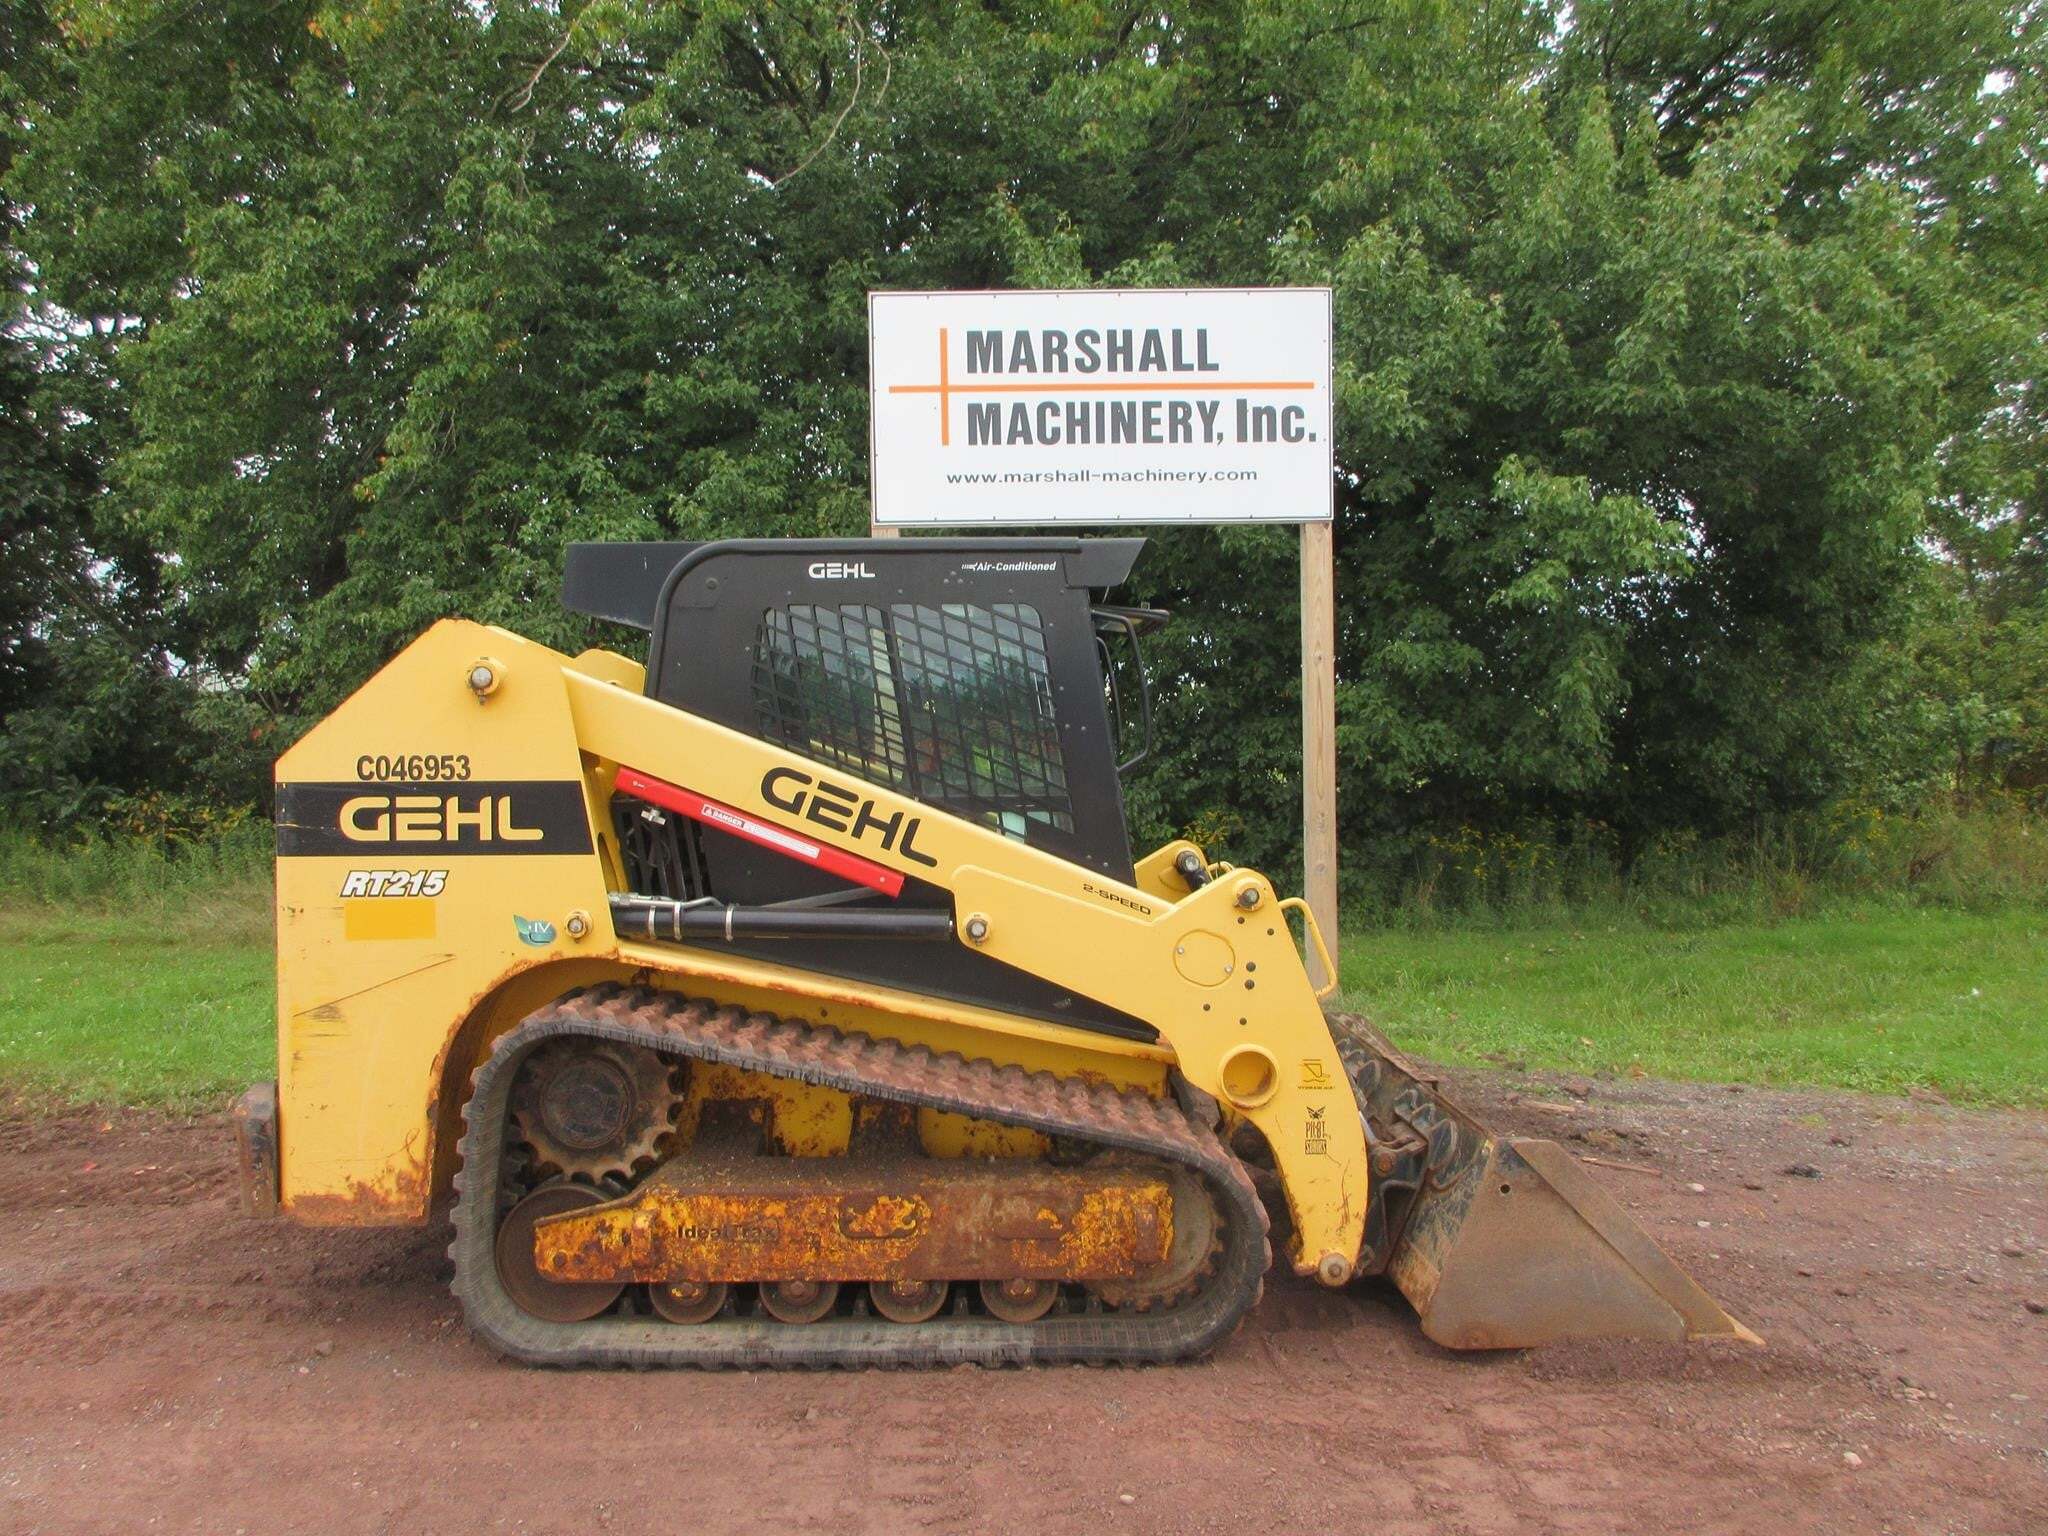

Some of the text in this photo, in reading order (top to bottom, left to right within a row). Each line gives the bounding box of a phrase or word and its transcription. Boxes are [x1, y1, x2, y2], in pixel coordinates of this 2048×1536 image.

[966, 329, 1219, 374] MARSHALL
[967, 398, 1317, 446] MACHINERY, Inc.
[946, 469, 1258, 485] www.marshall-machinery.com
[808, 562, 876, 579] GEHL
[976, 561, 1057, 571] Air-Conditioned
[356, 755, 472, 781] C046953
[339, 795, 545, 842] GEHL
[760, 767, 938, 868] GEHL
[340, 870, 450, 897] RT215
[1083, 883, 1151, 915] 2-SPEED
